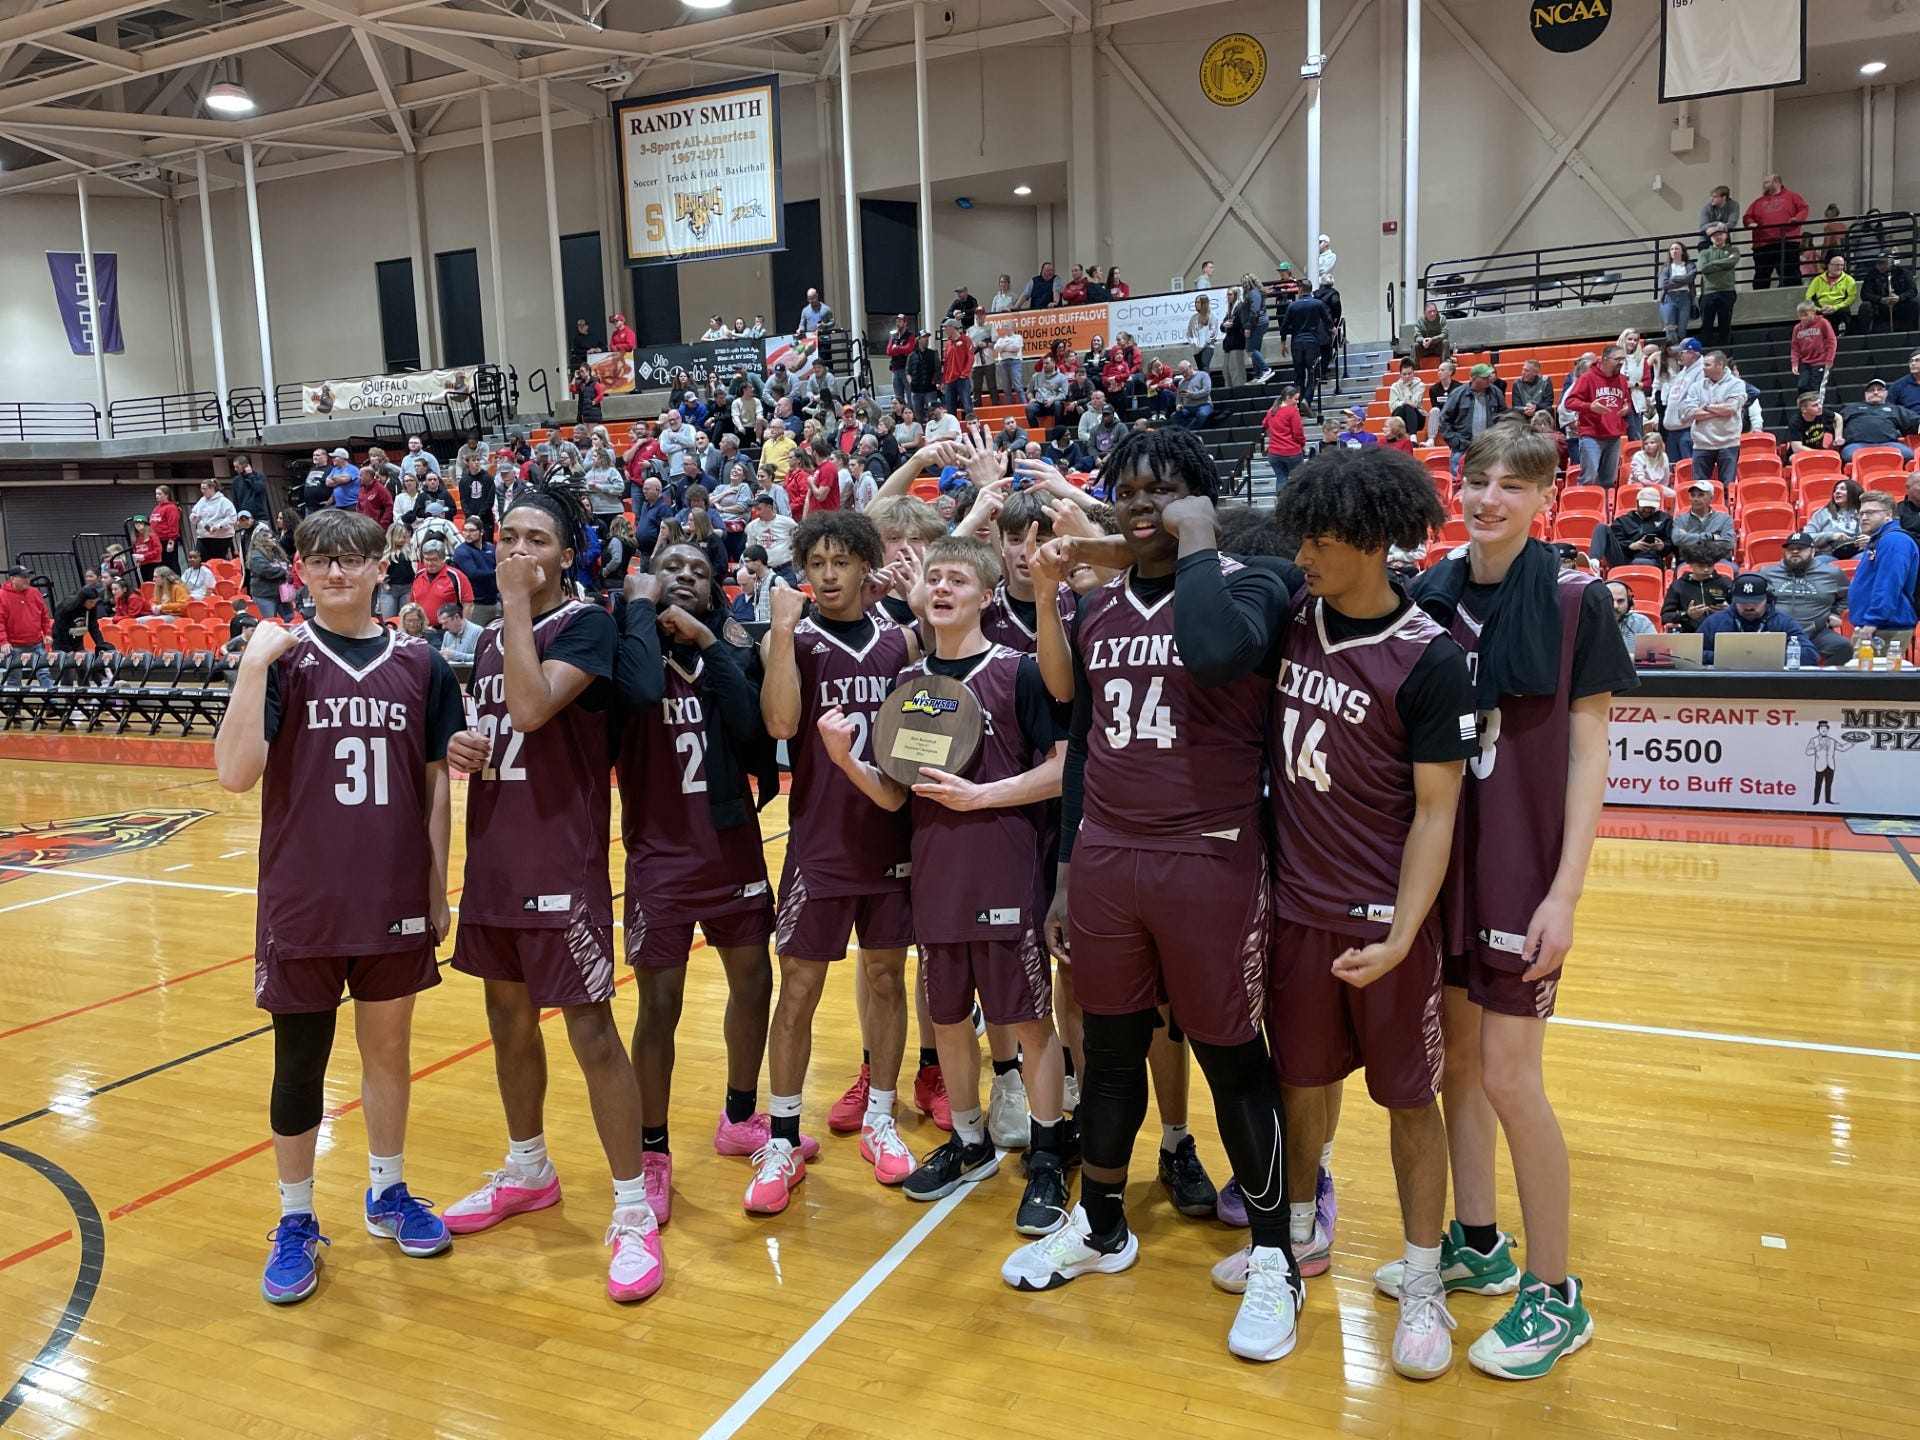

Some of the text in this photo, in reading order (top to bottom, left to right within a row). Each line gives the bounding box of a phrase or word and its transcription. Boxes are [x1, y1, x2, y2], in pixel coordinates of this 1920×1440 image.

[1534, 0, 1608, 28] NCAA
[630, 99, 762, 135] RANDY SMITH
[640, 130, 756, 155] 3-Sport All-American
[671, 147, 725, 165] 1967-1971
[633, 162, 765, 189] Soccer Track & Field Basketball
[645, 203, 665, 242] S
[1020, 317, 1036, 327] OFF
[1038, 314, 1056, 326] OUR
[1058, 309, 1107, 323] BUFFALOVE
[1116, 298, 1219, 320] chartwes
[1015, 325, 1076, 339] ROUGH LOCAL
[361, 379, 408, 395] BUFFALO
[349, 392, 433, 411] OLDE BREWERY
[820, 676, 892, 707] LYON
[1276, 658, 1371, 725] LYONS
[306, 696, 407, 731] LYONS
[662, 696, 703, 725] LYO
[1104, 676, 1176, 749] 34
[1608, 707, 1657, 723] IZZA
[1677, 708, 1759, 725] GRANT
[1766, 709, 1799, 726] ST.
[478, 714, 527, 781] 22
[845, 711, 878, 765] 2
[1282, 707, 1331, 792] 14
[334, 736, 388, 805] 31
[676, 731, 708, 794] 2
[1607, 776, 1796, 796] very to Buff State
[1493, 935, 1505, 946] XL
